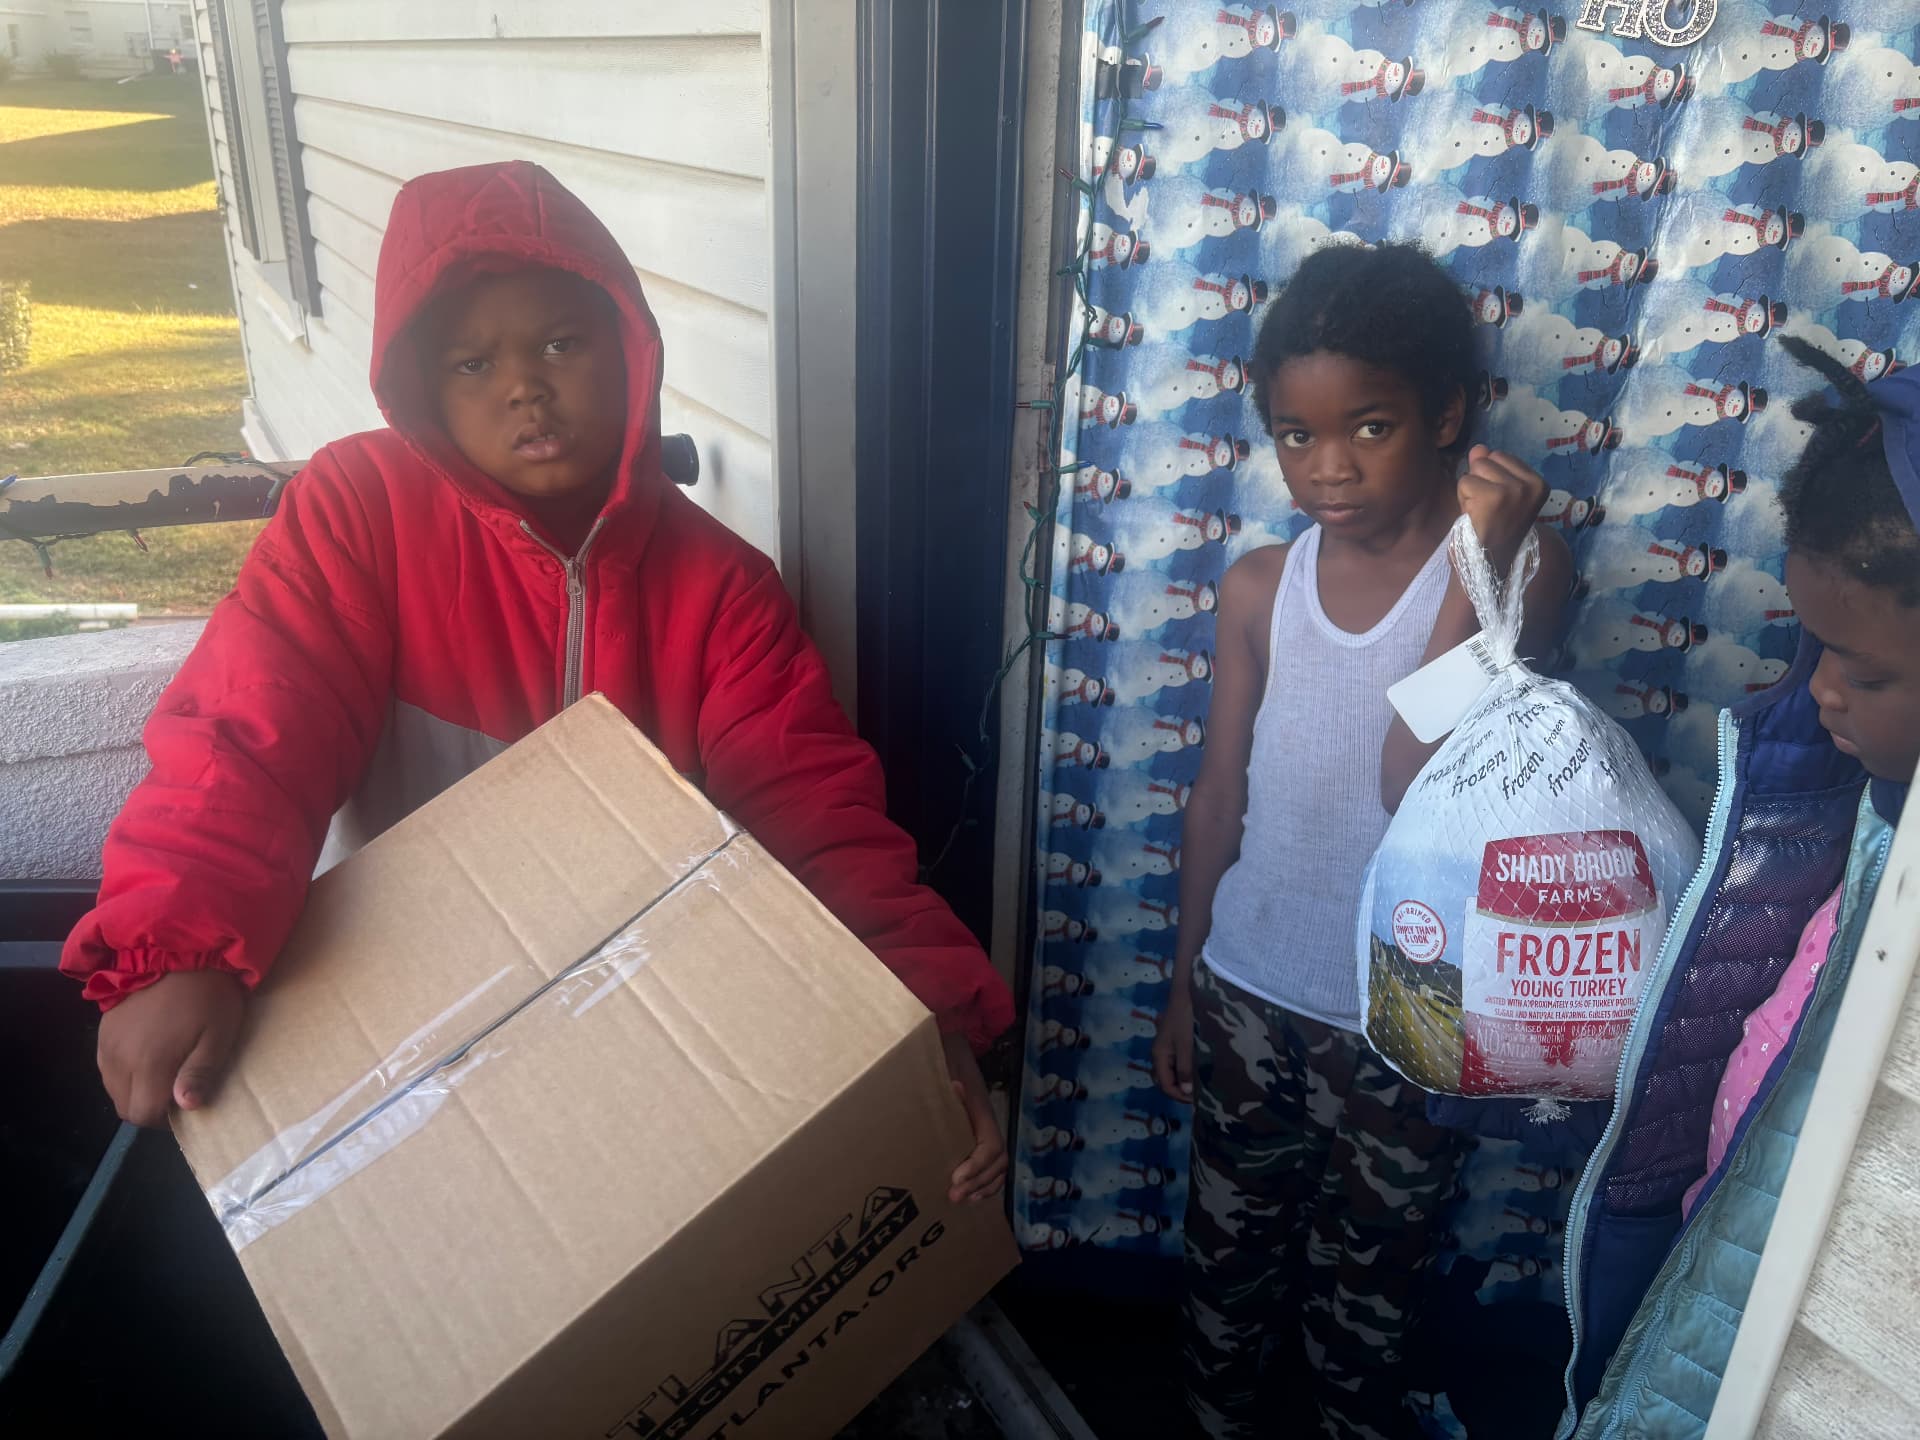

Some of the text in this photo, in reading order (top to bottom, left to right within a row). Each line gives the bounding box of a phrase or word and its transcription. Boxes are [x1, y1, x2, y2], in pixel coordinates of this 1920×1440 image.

[1575, 0, 1718, 47] HO
[1544, 718, 1565, 748] frozen
[1451, 749, 1507, 797] frozen
[1502, 750, 1545, 800] frozen
[1547, 737, 1592, 797] frozen
[1495, 846, 1640, 884] SHADY BROOK
[1496, 928, 1641, 976] FROZEN
[1507, 998, 1522, 1008] WITH
[1584, 999, 1591, 1008] OF
[1593, 998, 1614, 1008] TURKEY
[1511, 977, 1628, 998] YOUNG TURKEY
[1514, 1023, 1542, 1033] RAISED
[774, 1206, 910, 1338] MINISTRY
